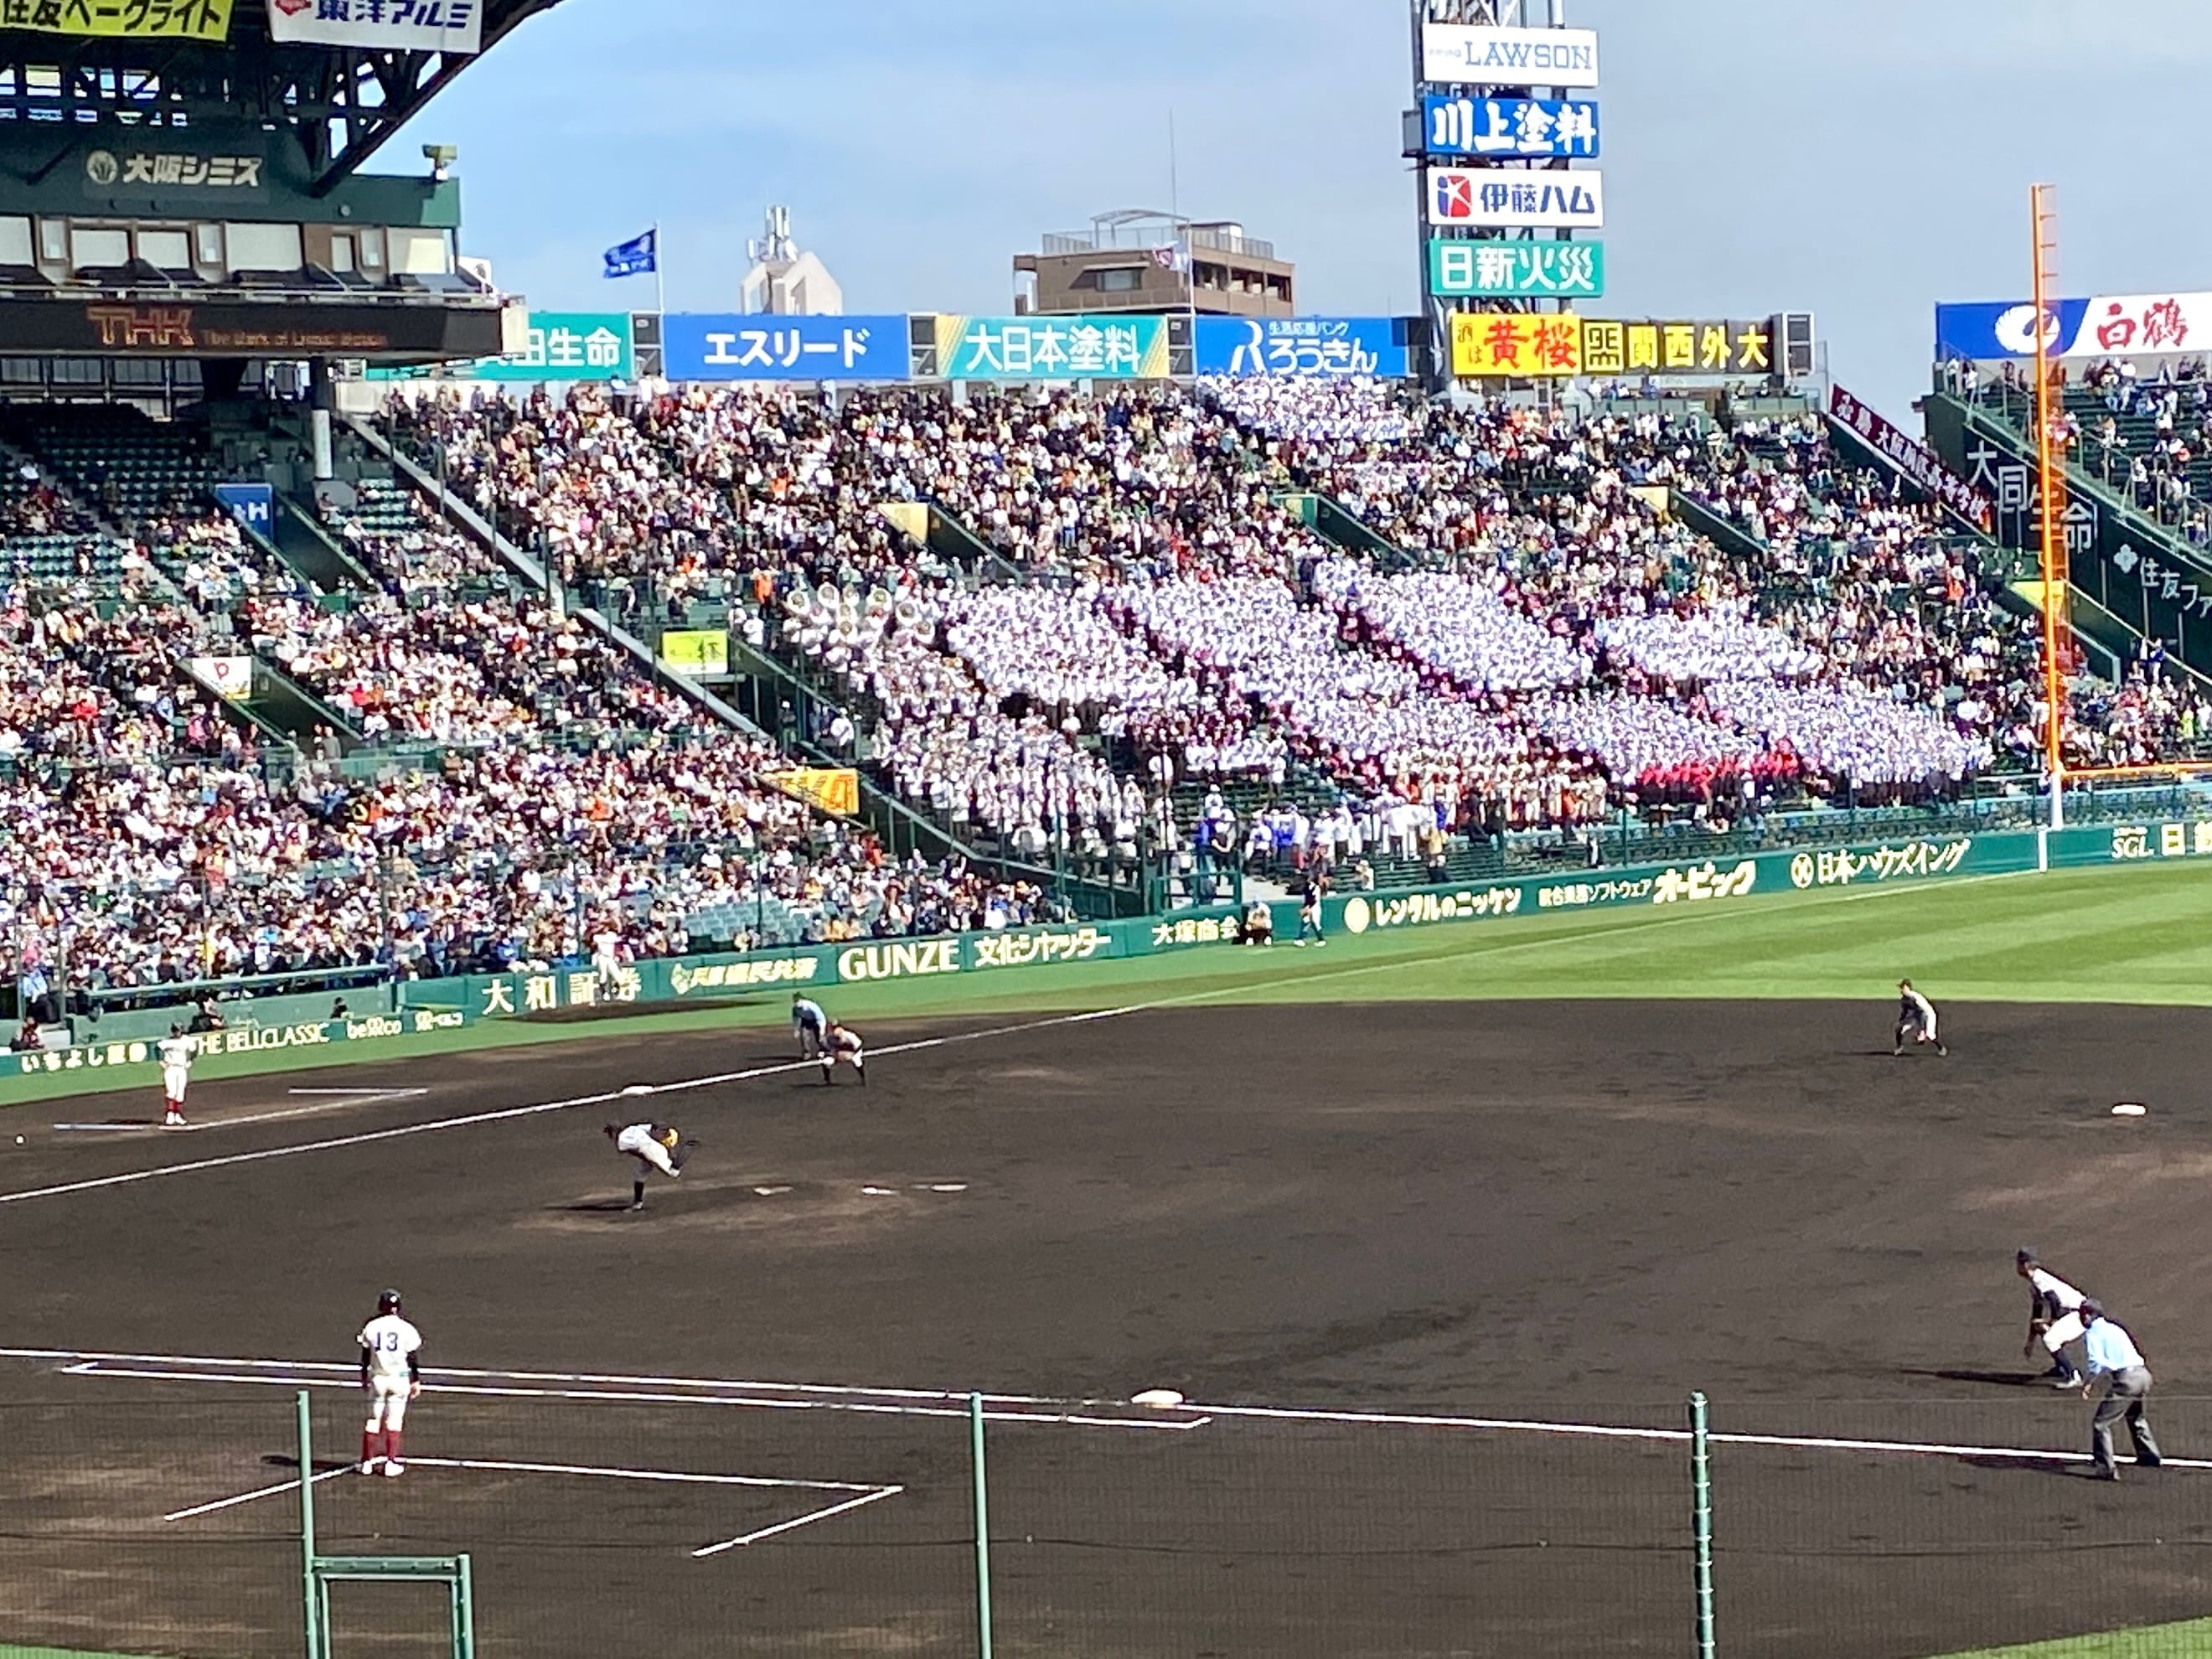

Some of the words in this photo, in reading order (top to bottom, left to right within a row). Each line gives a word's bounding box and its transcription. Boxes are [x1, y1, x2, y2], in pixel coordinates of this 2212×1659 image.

[1465, 41, 1592, 70] LAWSON
[1432, 100, 1597, 153] 川上塗料
[1481, 183, 1595, 214] 伊藤ハム
[1440, 245, 1595, 290] 日新火災
[87, 307, 194, 346] THK
[1484, 318, 1577, 369] 黄桜
[2097, 297, 2189, 350] 白鶴
[498, 326, 621, 367] 田生命
[704, 328, 871, 369] エスリード
[965, 323, 1141, 373] 大日本塗料
[1269, 337, 1377, 375] ろうきん
[1628, 324, 1770, 370] 関西外大
[1967, 440, 2093, 555] 大同生命
[1653, 861, 1756, 904] オービック
[1376, 887, 1522, 927] レンタルのニッケン
[1151, 915, 1240, 946] 大塚商会
[839, 939, 960, 979] GUNZE
[375, 1331, 398, 1351] 13
